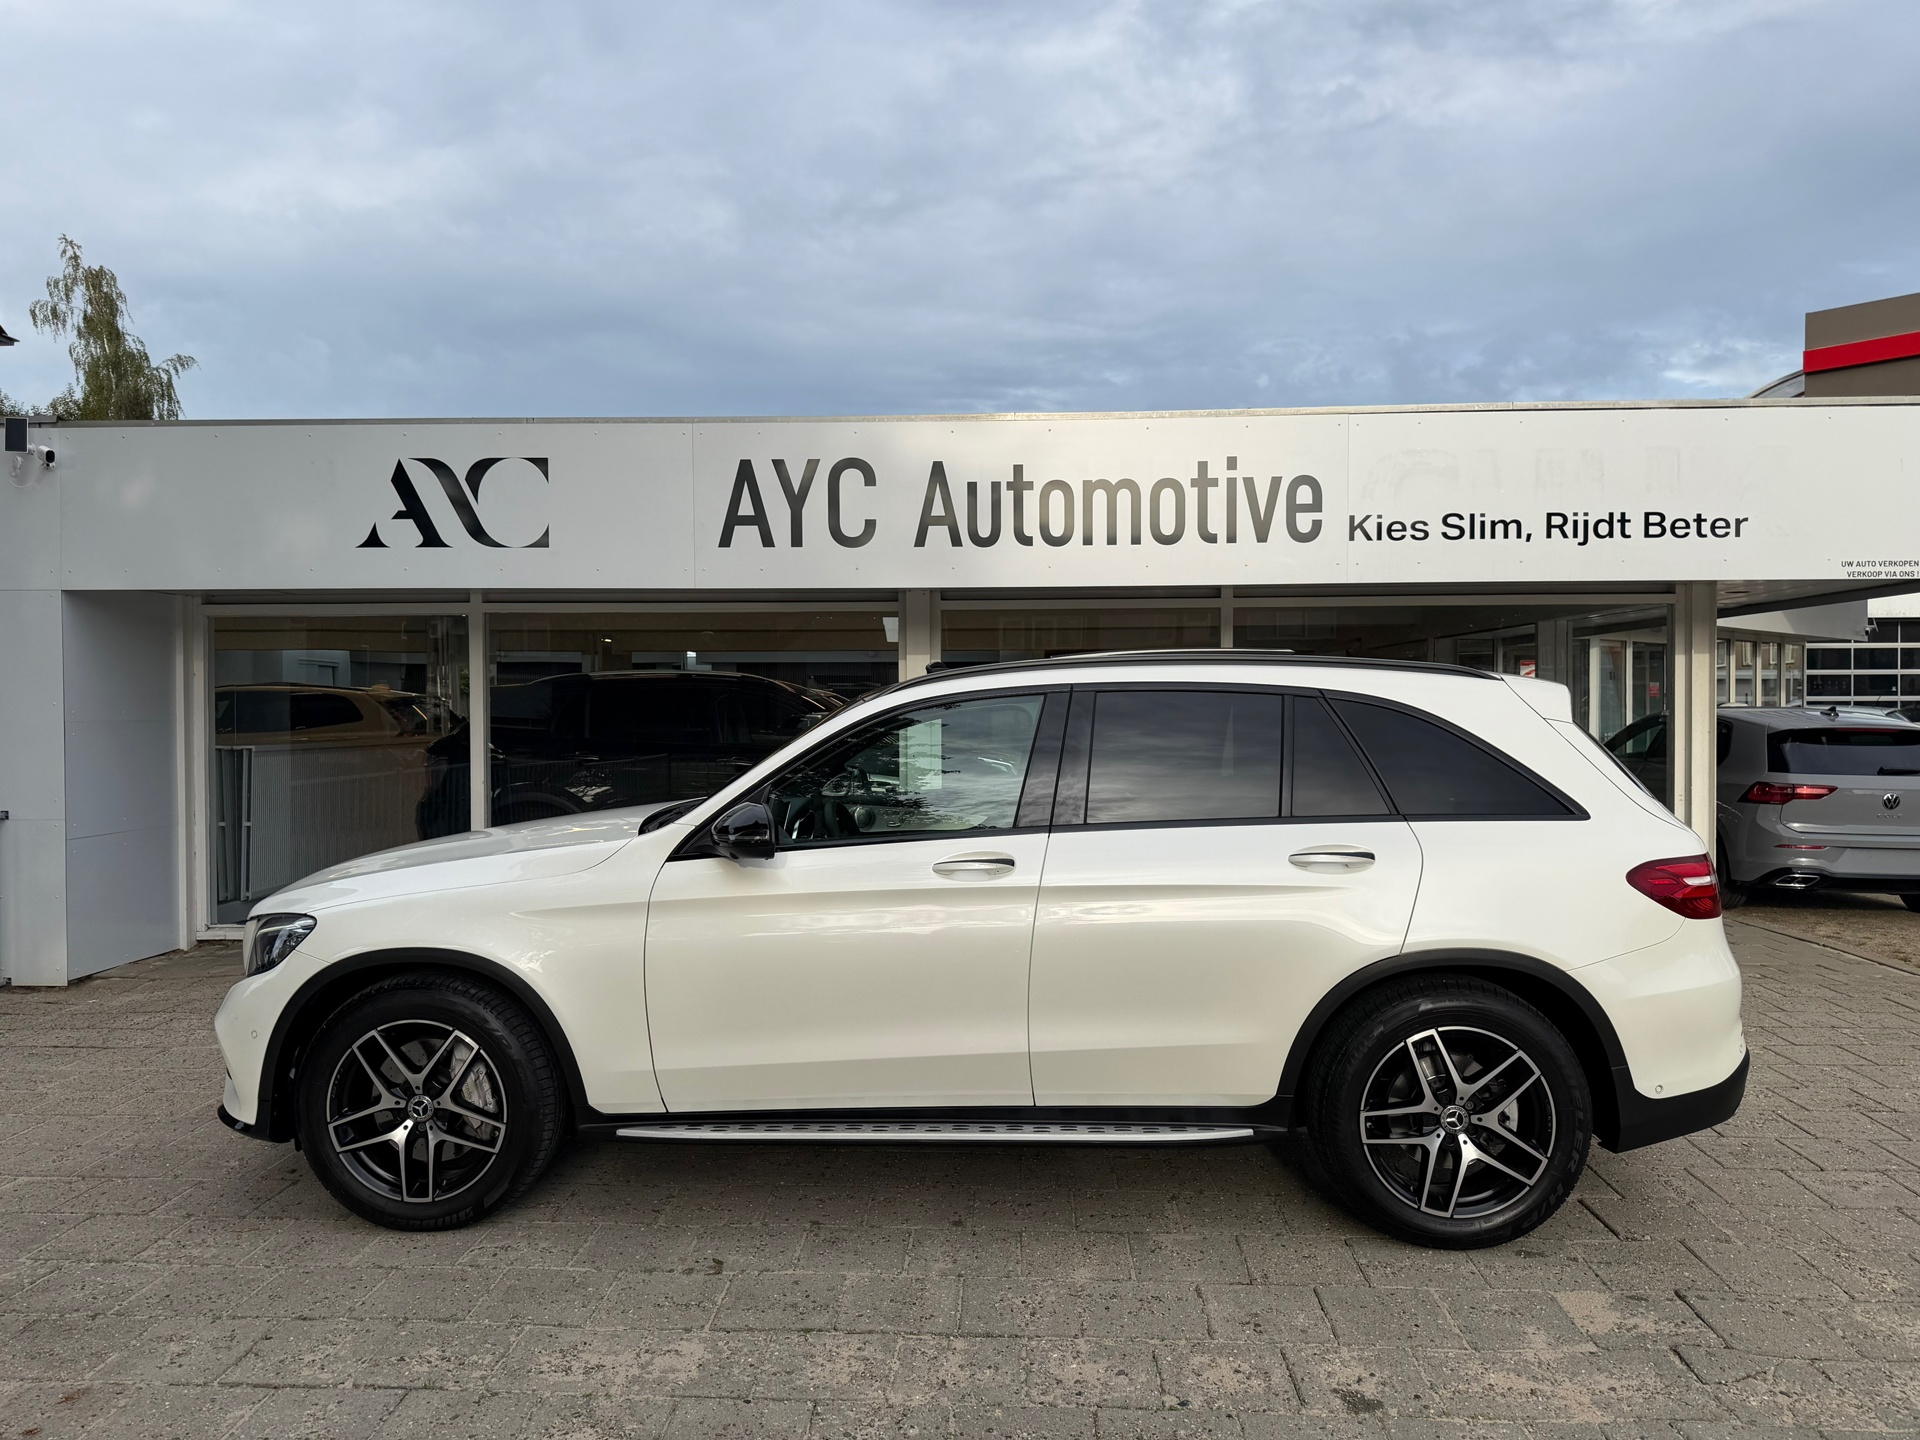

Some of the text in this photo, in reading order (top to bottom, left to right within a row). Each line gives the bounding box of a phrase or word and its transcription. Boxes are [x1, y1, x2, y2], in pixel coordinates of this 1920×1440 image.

[718, 458, 876, 548] AYC
[914, 457, 1323, 548] Automotive
[1349, 511, 1749, 547] Kies Slim, Rijdt Beter
[1841, 560, 1920, 568] UW AUTO VERKOPEN
[1846, 570, 1883, 578] VERKOOP
[1884, 570, 1898, 578] VIA
[1899, 570, 1916, 578] ONS
